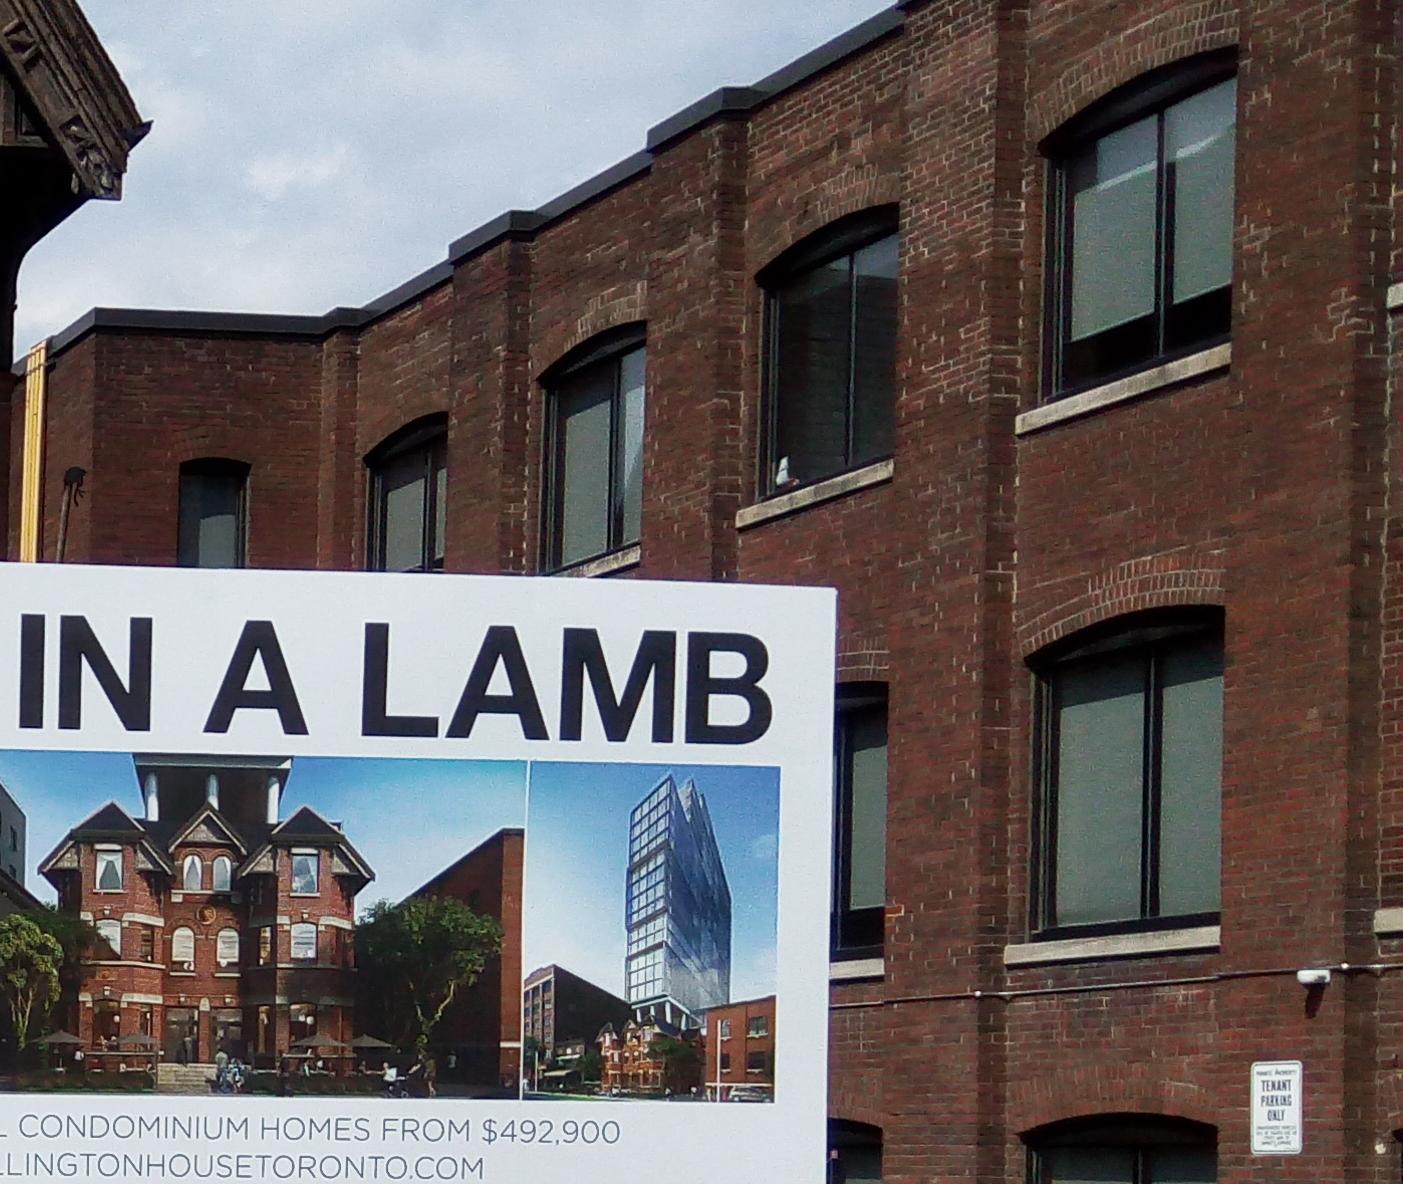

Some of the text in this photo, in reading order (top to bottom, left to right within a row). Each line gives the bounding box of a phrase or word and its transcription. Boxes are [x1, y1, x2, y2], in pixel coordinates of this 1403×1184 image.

[18, 613, 153, 732] IN
[202, 619, 310, 736] A
[360, 622, 773, 746] LAMB
[1261, 1080, 1292, 1092] TENANT
[1261, 1095, 1292, 1107] PARKING
[1267, 1109, 1285, 1121] ONLY
[18, 1114, 249, 1141] CONDOMINIUM
[261, 1117, 371, 1142] HOMES
[382, 1118, 470, 1143] FROM
[481, 1118, 621, 1146] $492,900
